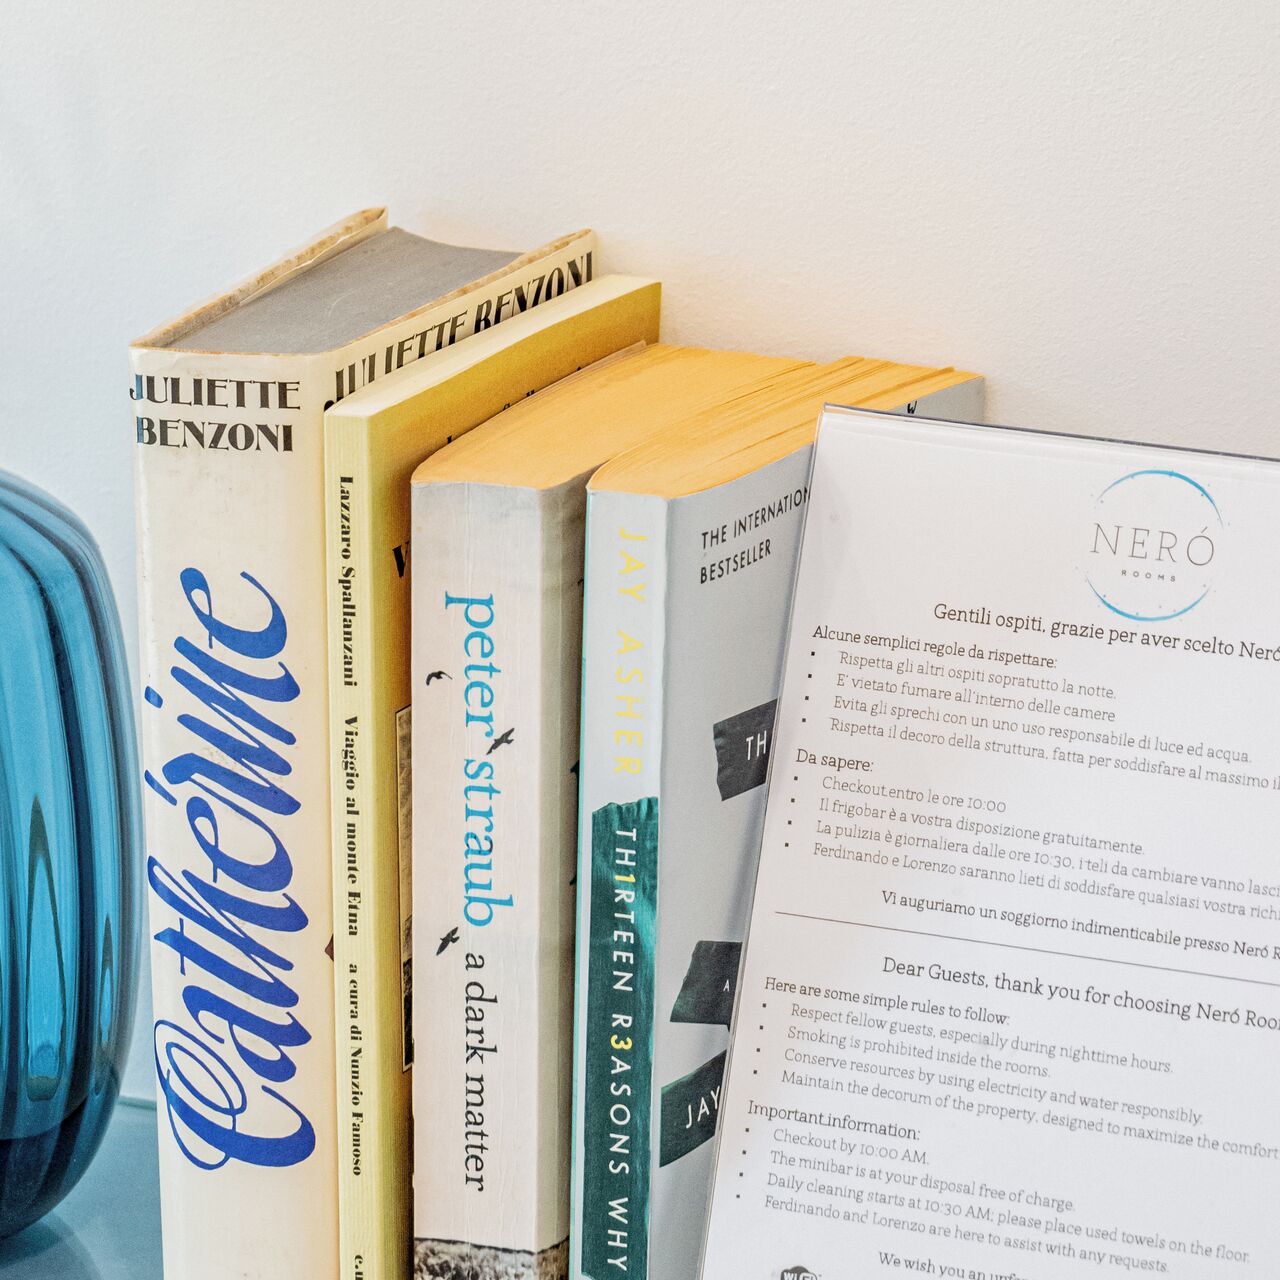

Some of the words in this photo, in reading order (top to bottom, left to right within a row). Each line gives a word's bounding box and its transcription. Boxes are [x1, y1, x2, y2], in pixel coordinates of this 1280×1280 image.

[130, 375, 300, 410] JULIETTE
[137, 417, 293, 452] BENZONI
[340, 477, 353, 559] Lazzaro
[701, 524, 727, 549] THE
[618, 527, 648, 602] JAY
[700, 538, 771, 584] BESTSELLER
[1090, 522, 1215, 566] NERÓ
[1121, 569, 1177, 583] ROOMS
[338, 567, 357, 686] Spallanzani
[811, 624, 862, 644] Alcune
[863, 634, 921, 652] semplici
[922, 641, 966, 658] regole
[967, 643, 985, 660] da
[933, 602, 991, 626] Gentili
[1049, 620, 1105, 640] grazie
[1106, 628, 1138, 645] per
[1140, 632, 1181, 649] aver
[1183, 635, 1235, 656] scelto
[445, 592, 503, 738] peter
[838, 650, 893, 670] Rispetta
[896, 657, 913, 675] gli
[916, 660, 945, 677] altri
[947, 668, 985, 683] ospiti
[987, 673, 1059, 692] sopratutto
[1061, 678, 1074, 694] la
[614, 630, 644, 774] ASHER
[851, 677, 898, 694] vietato
[900, 681, 952, 701] fumare
[954, 688, 1025, 710] all'interno
[1027, 697, 1061, 715] delle
[1063, 705, 1116, 722] camere
[342, 716, 359, 790] Viaggio
[746, 730, 767, 760] TH
[795, 747, 817, 765] Da
[346, 797, 359, 815] al
[822, 775, 888, 797] Checkout
[888, 787, 924, 802] entro
[927, 788, 940, 804] le
[941, 795, 964, 807] ore
[966, 797, 1006, 813] 10:00
[819, 797, 829, 812] Il
[831, 799, 887, 819] frigobar
[888, 807, 897, 821] è
[898, 811, 907, 822] a
[910, 813, 952, 829] vostra
[955, 815, 1040, 841] disposizione
[347, 823, 359, 884] monte
[464, 759, 513, 927] straub
[348, 892, 361, 935] Etna
[613, 829, 636, 991] TH1RTEEN
[881, 889, 897, 905] Vi
[899, 895, 976, 916] auguriamo
[978, 907, 998, 920] un
[999, 910, 1068, 930] soggiorno
[1070, 917, 1181, 946] indimenticabile
[1183, 936, 1230, 953] presso
[1232, 940, 1269, 959] Neró
[349, 964, 357, 973] a
[465, 953, 484, 971] a
[350, 979, 358, 1019] cura
[763, 976, 797, 994] Here
[798, 984, 822, 997] are
[823, 988, 860, 1003] some
[862, 992, 908, 1012] simple
[910, 998, 945, 1016] rules
[948, 1004, 962, 1018] to
[881, 955, 925, 978] Dear
[994, 971, 1044, 996] thank
[1046, 984, 1080, 1001] you
[1083, 984, 1111, 1005] for
[1113, 989, 1192, 1022] choosing
[1195, 1001, 1240, 1024] Neró
[351, 1025, 362, 1040] di
[465, 982, 498, 1064] dark
[790, 1002, 843, 1023] Respect
[845, 1010, 888, 1029] fellow
[939, 1028, 1009, 1051] especially
[1010, 1035, 1056, 1059] during
[1059, 1045, 1128, 1066] nighttime
[787, 1025, 847, 1050] Smoking
[849, 1035, 861, 1049] is
[863, 1039, 934, 1060] prohibited
[936, 1048, 977, 1066] inside
[980, 1053, 1002, 1070] the
[351, 1048, 363, 1106] Nunzio
[609, 1014, 632, 1173] R3ASONS
[685, 1085, 721, 1129] JAY
[747, 1099, 825, 1126] Important
[352, 1112, 363, 1176] Famoso
[465, 1073, 488, 1192] matter
[773, 1128, 837, 1150] Checkout
[839, 1137, 857, 1156] by
[859, 1143, 898, 1160] 10:00
[770, 1149, 796, 1167] The
[798, 1157, 853, 1175] minibar
[855, 1164, 866, 1178] is
[868, 1168, 882, 1180] at
[884, 1171, 918, 1186] your
[919, 1173, 976, 1196] disposal
[978, 1183, 1006, 1200] free
[1008, 1189, 1025, 1203] of
[608, 1198, 628, 1270] WHY
[878, 1251, 901, 1267] We
[903, 1257, 936, 1274] wish
[938, 1264, 965, 1279] you
